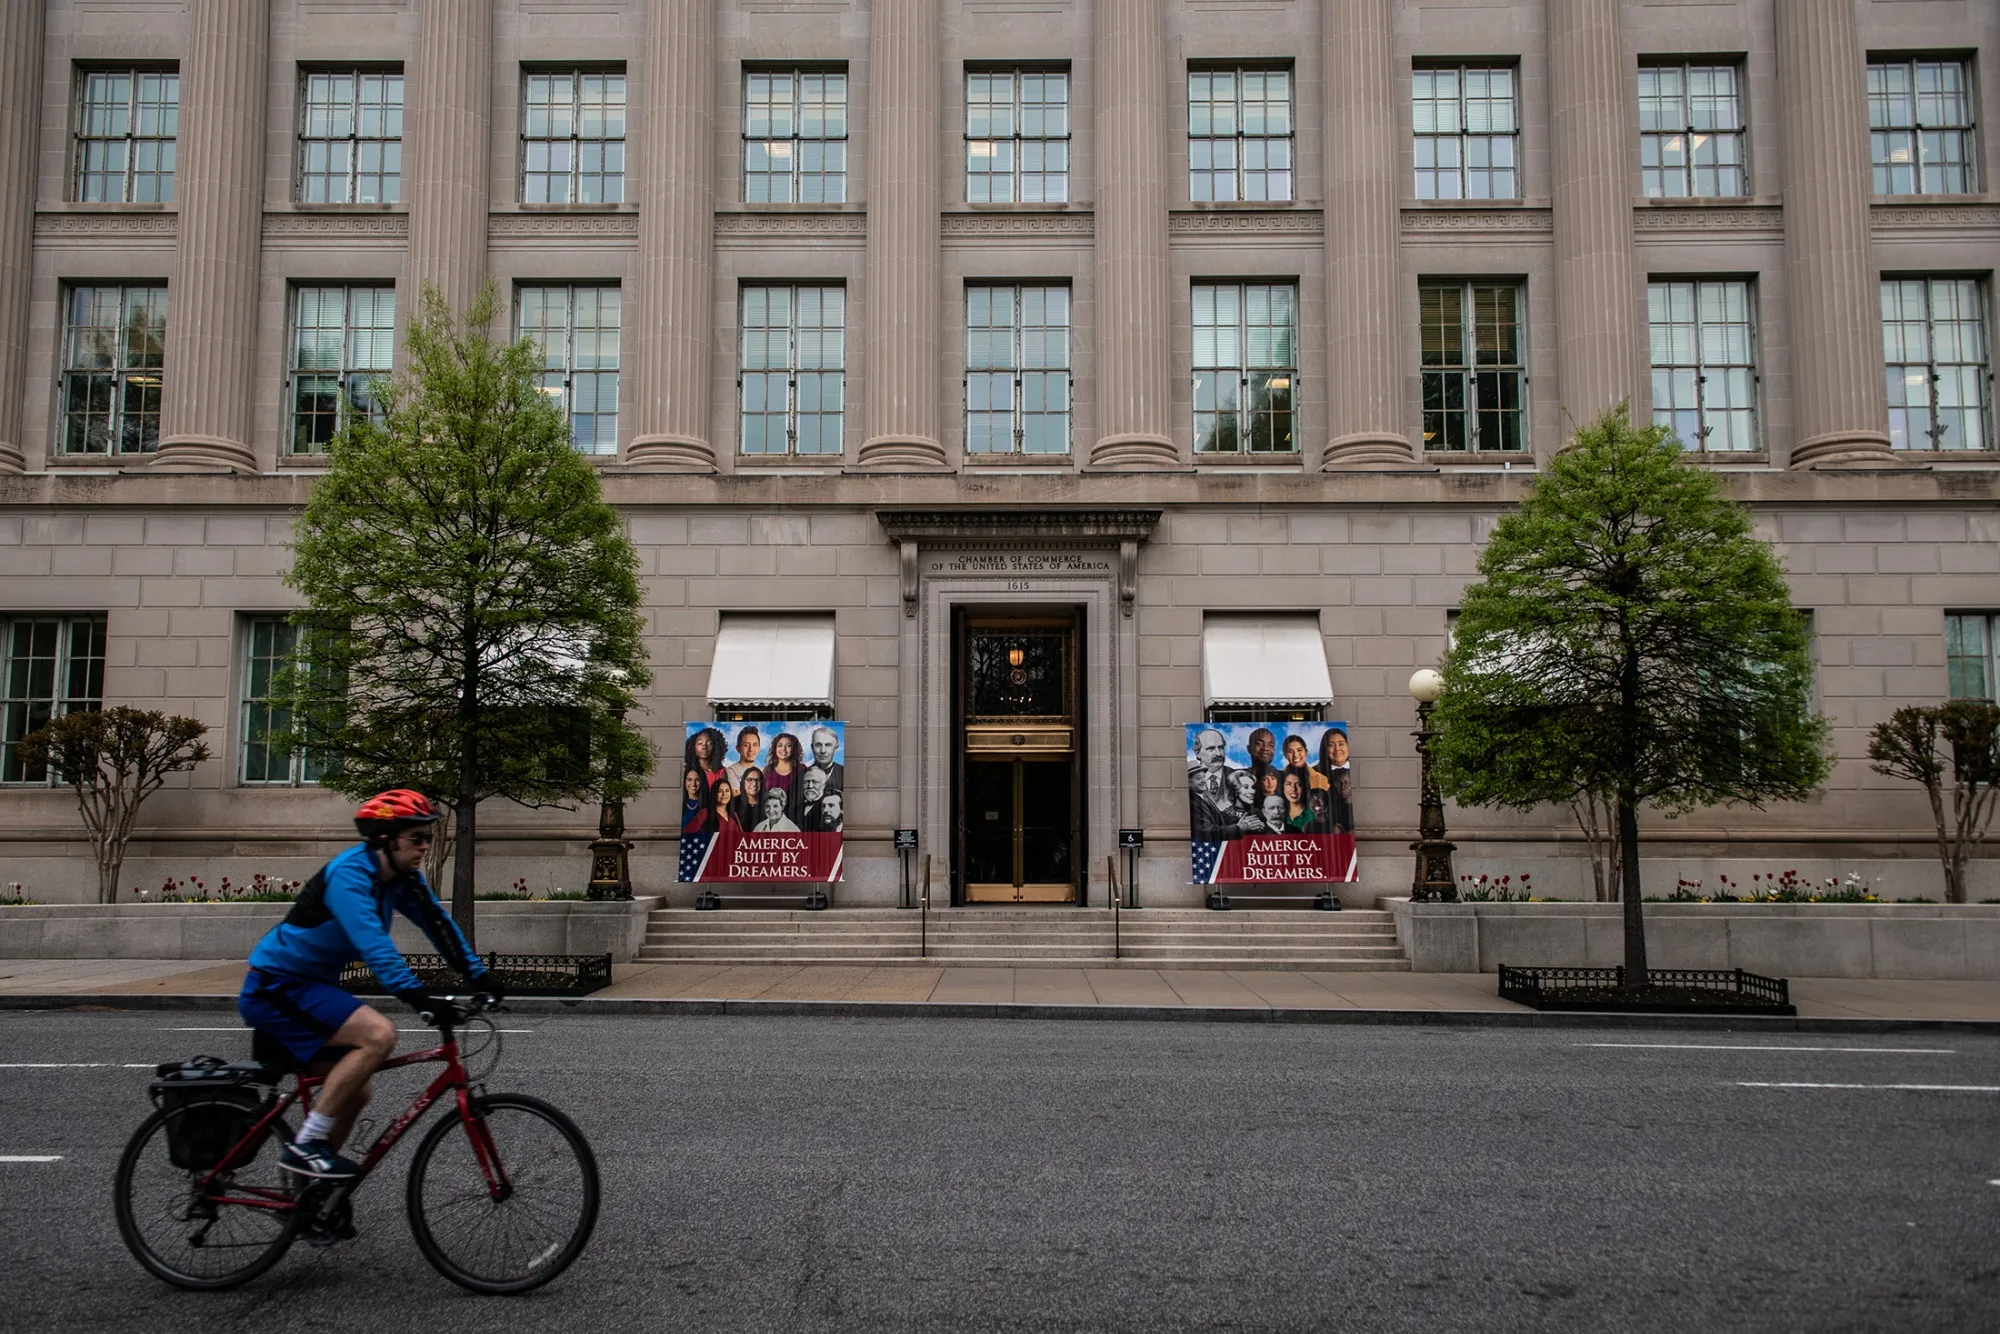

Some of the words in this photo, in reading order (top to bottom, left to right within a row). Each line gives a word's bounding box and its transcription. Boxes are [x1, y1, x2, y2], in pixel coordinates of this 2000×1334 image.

[958, 555, 1005, 563] CHAMBER
[1009, 555, 1022, 563] OF
[1027, 555, 1083, 563] COMMERCE
[1066, 562, 1110, 570] AMERICA
[1007, 582, 1030, 590] 1615
[737, 837, 808, 850] AMERICA.
[1249, 839, 1322, 852] AMERICA.
[734, 850, 777, 864] BUILT
[781, 852, 800, 864] BY
[1246, 853, 1291, 866] BUILT
[1295, 853, 1314, 865] BY
[728, 864, 812, 878] DREAMERS.
[1242, 866, 1327, 880] DREAMERS.
